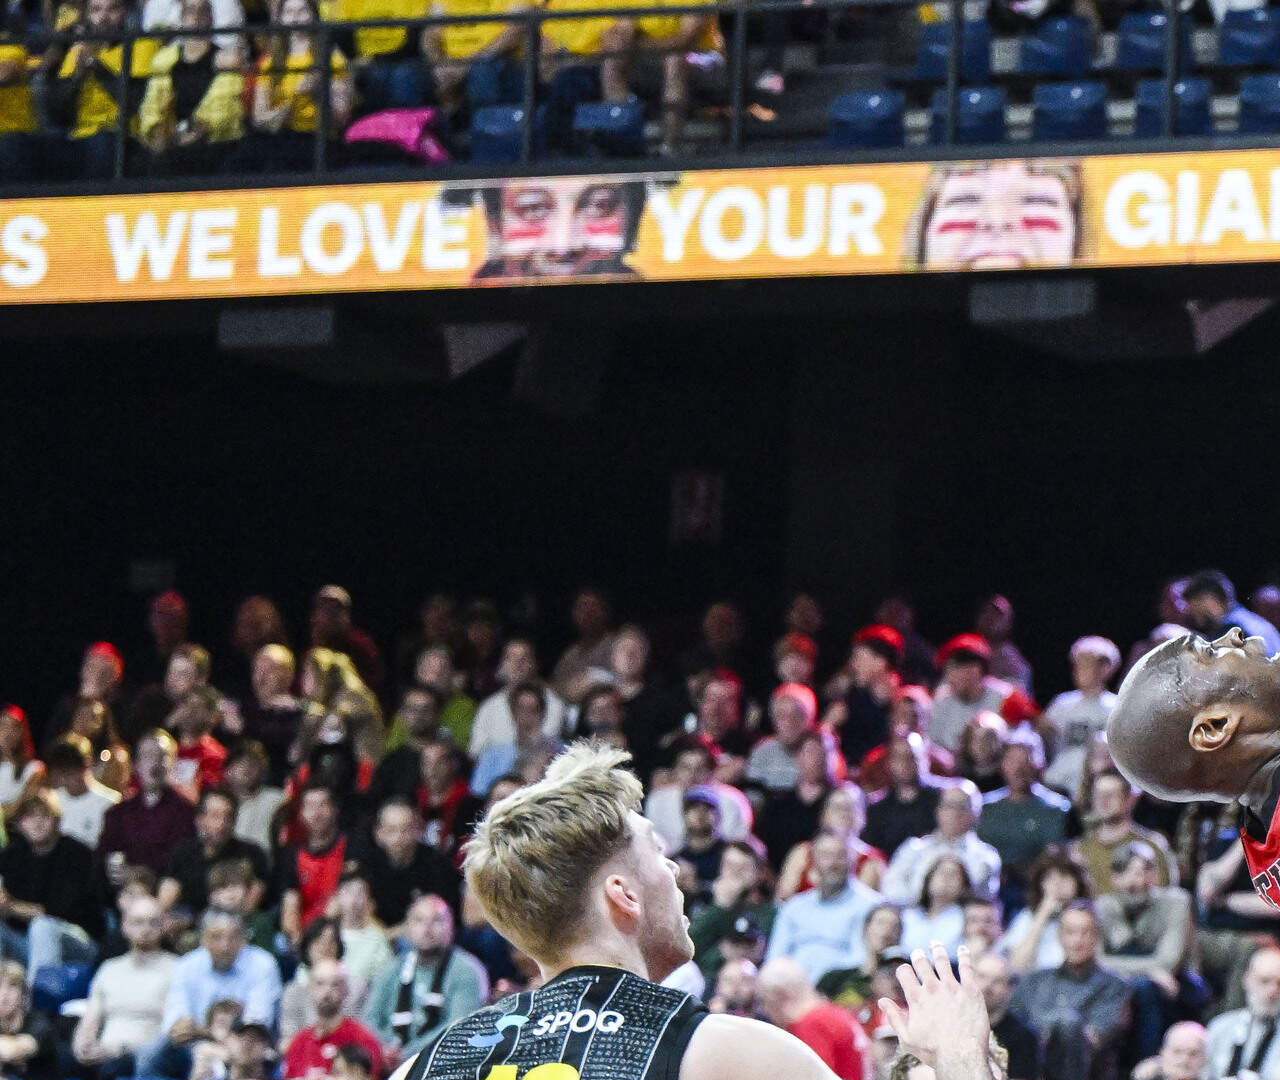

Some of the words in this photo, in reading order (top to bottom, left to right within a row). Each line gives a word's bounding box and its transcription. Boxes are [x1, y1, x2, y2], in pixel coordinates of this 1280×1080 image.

[107, 209, 235, 282] WE
[258, 199, 470, 278] LOVE
[648, 184, 885, 262] YOUR
[533, 1009, 625, 1036] SPOQ
